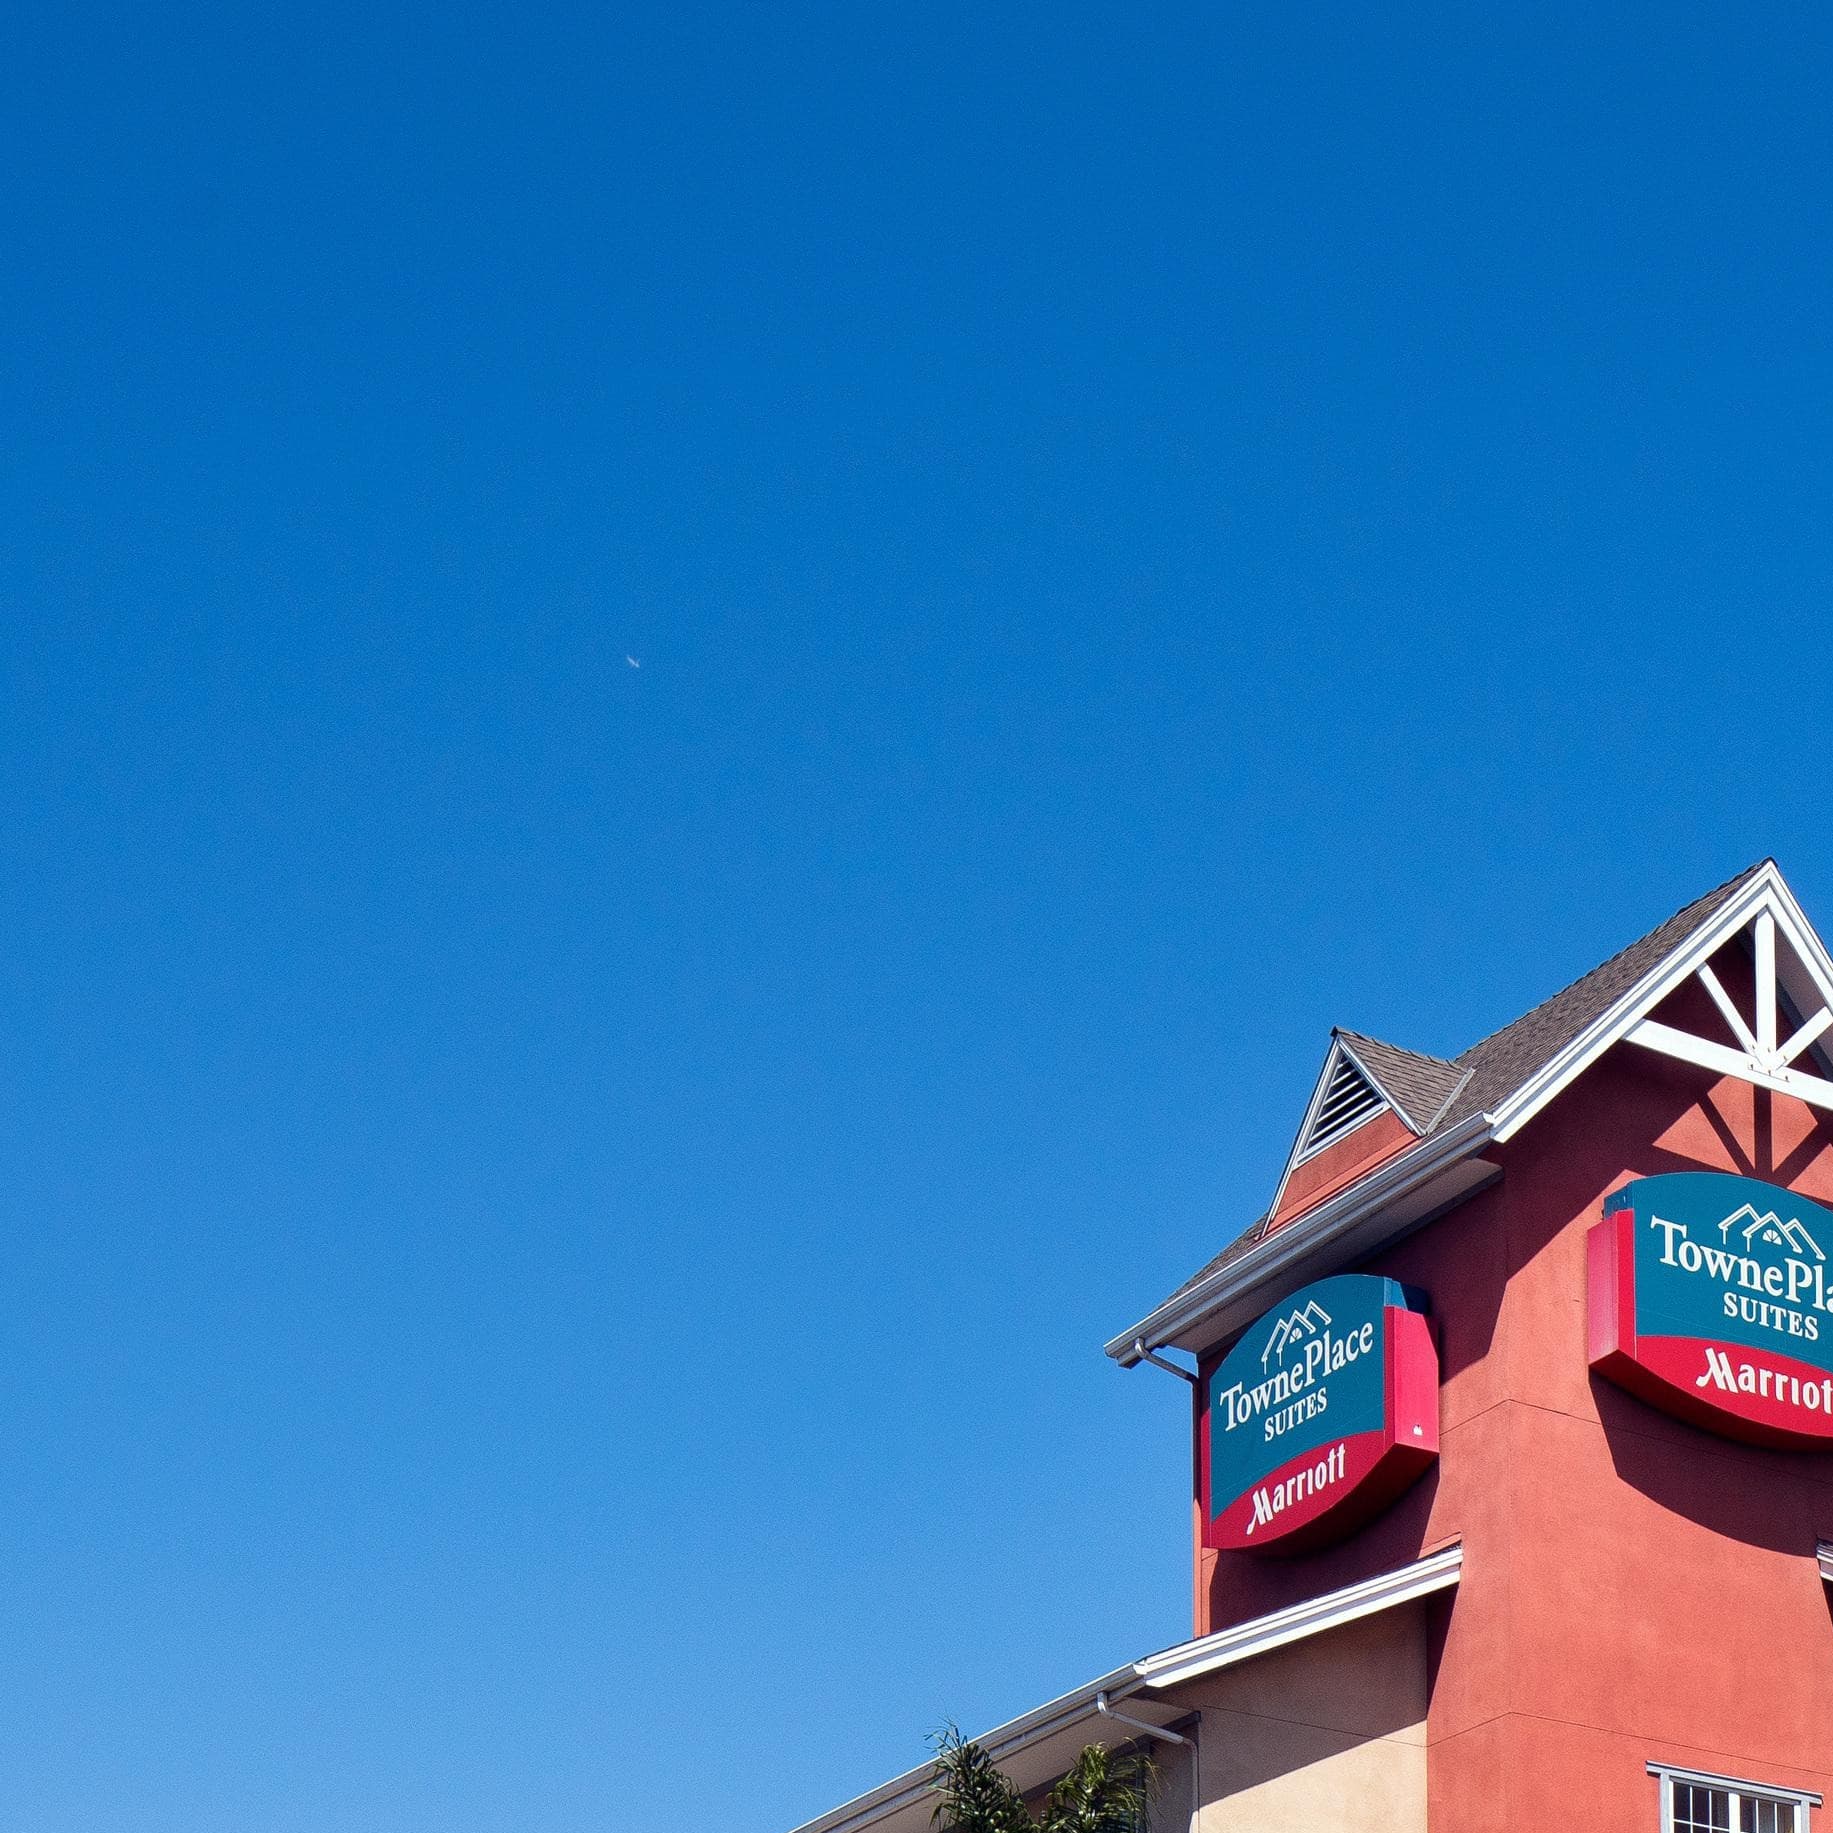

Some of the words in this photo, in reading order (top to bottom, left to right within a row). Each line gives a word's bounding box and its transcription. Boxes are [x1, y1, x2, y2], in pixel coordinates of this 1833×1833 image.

[1723, 1292, 1819, 1341] SUITES
[1219, 1322, 1374, 1432] TownePlace
[1264, 1387, 1328, 1442] SUITES
[1246, 1443, 1346, 1535] Marriott
